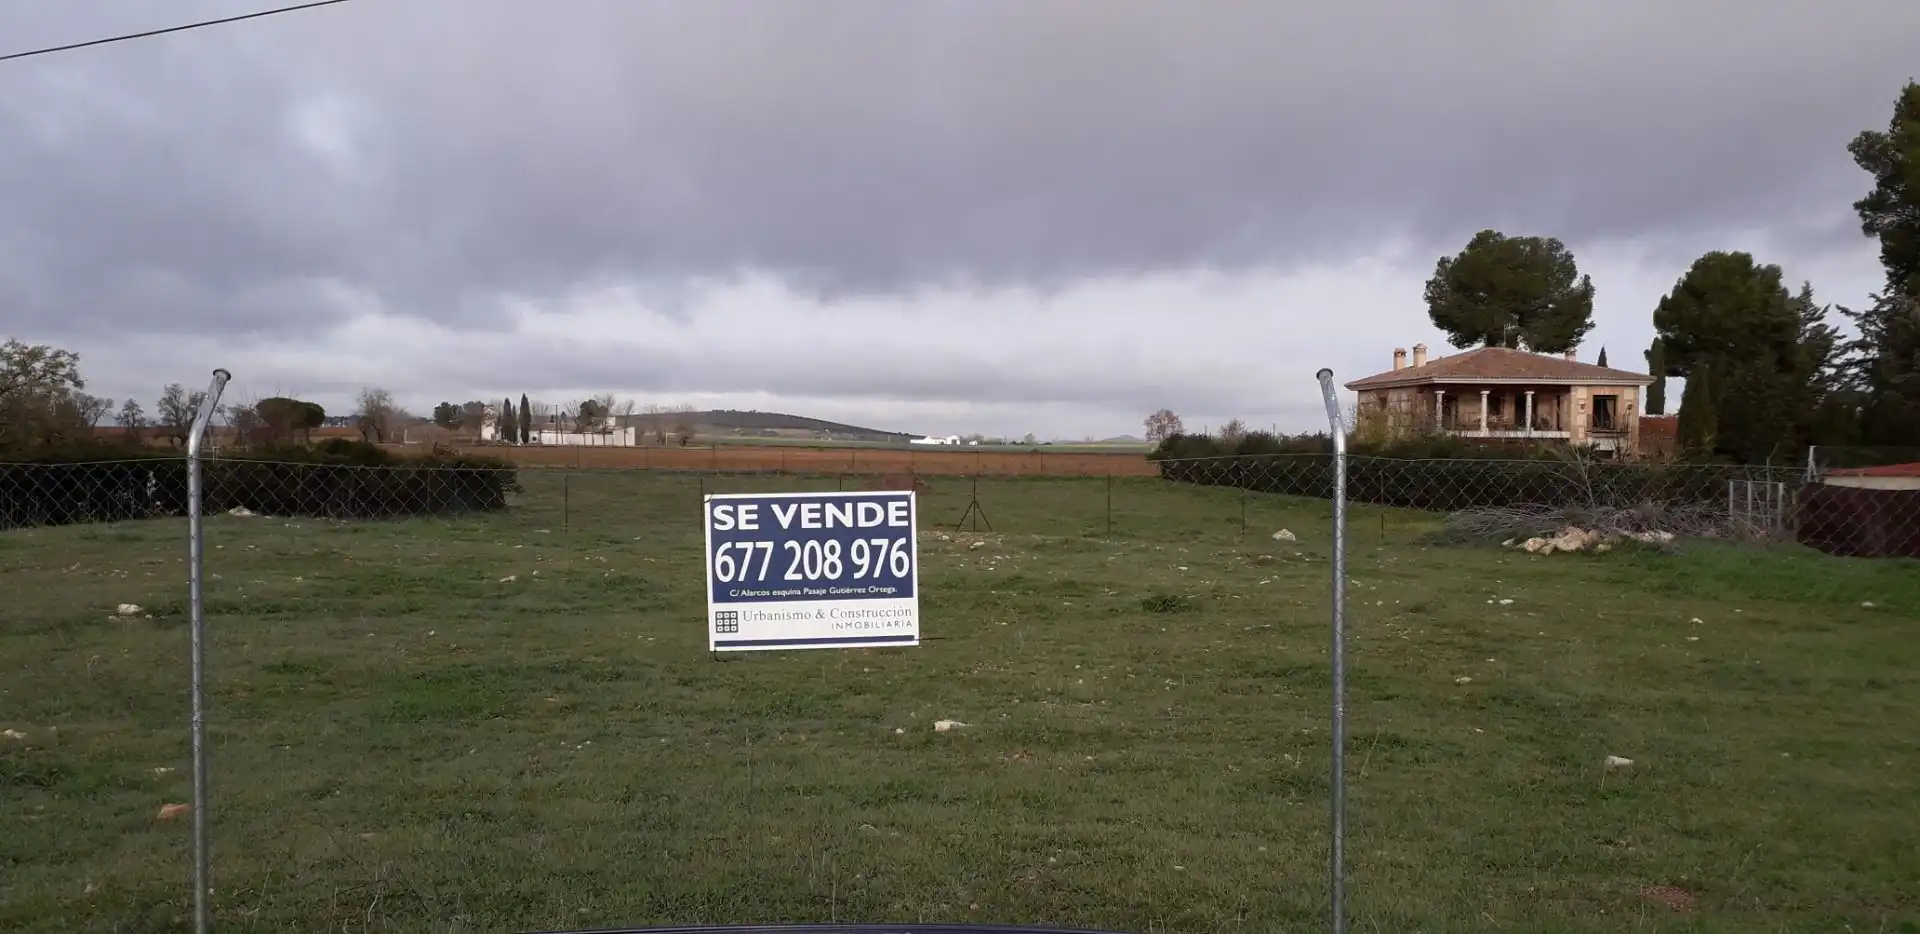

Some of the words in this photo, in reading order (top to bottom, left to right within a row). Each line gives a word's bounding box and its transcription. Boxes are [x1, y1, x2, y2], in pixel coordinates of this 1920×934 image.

[713, 504, 759, 531] SE
[770, 501, 909, 530] VENDE
[715, 541, 774, 583] 677
[784, 539, 843, 580] 208
[850, 537, 910, 579] 976
[729, 588, 739, 597] C/
[741, 588, 770, 597] Alarcos
[772, 588, 801, 598] esquina
[803, 586, 827, 596] Pasaje
[743, 609, 812, 622] Urbanismo
[815, 608, 826, 620] &
[830, 605, 913, 620] Construcción
[831, 619, 913, 630] INMOBILIARIA
